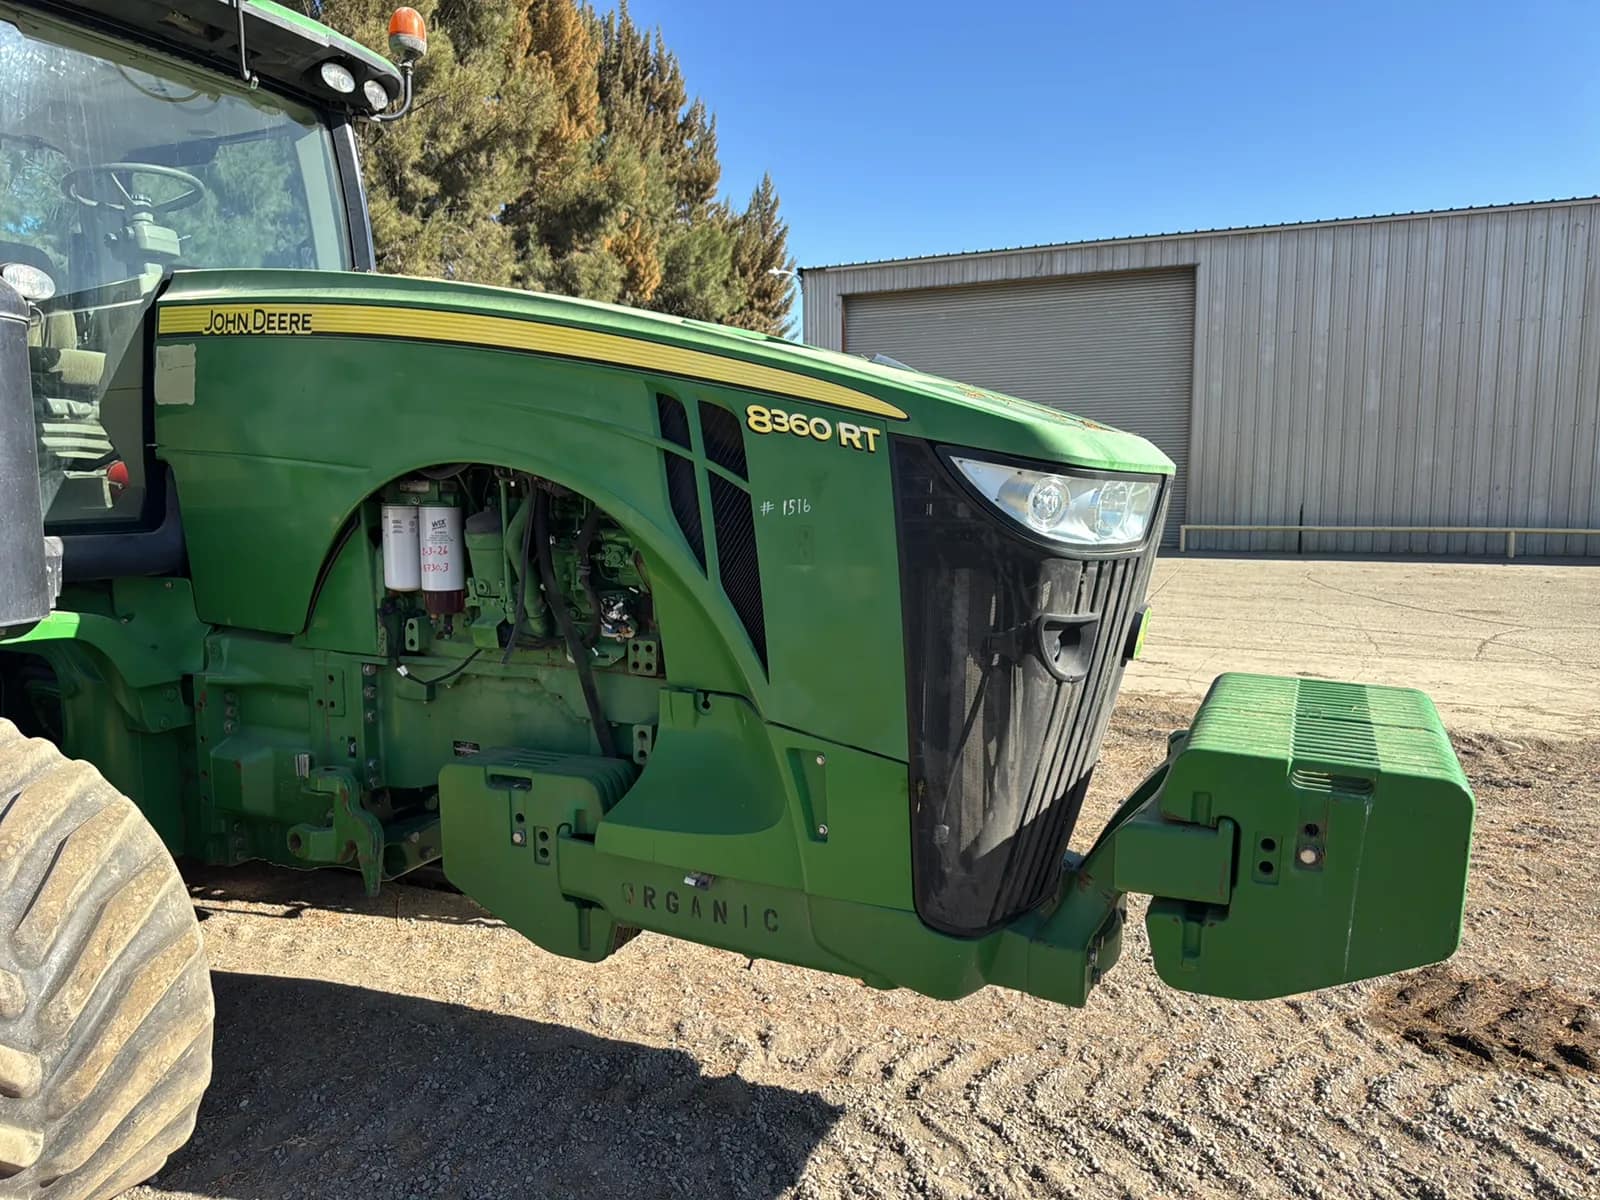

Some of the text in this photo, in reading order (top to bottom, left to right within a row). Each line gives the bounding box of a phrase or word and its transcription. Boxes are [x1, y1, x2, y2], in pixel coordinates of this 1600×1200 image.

[204, 308, 313, 332] JOHN DEERE
[746, 404, 881, 452] 8360 RT
[760, 498, 812, 516] # 1516
